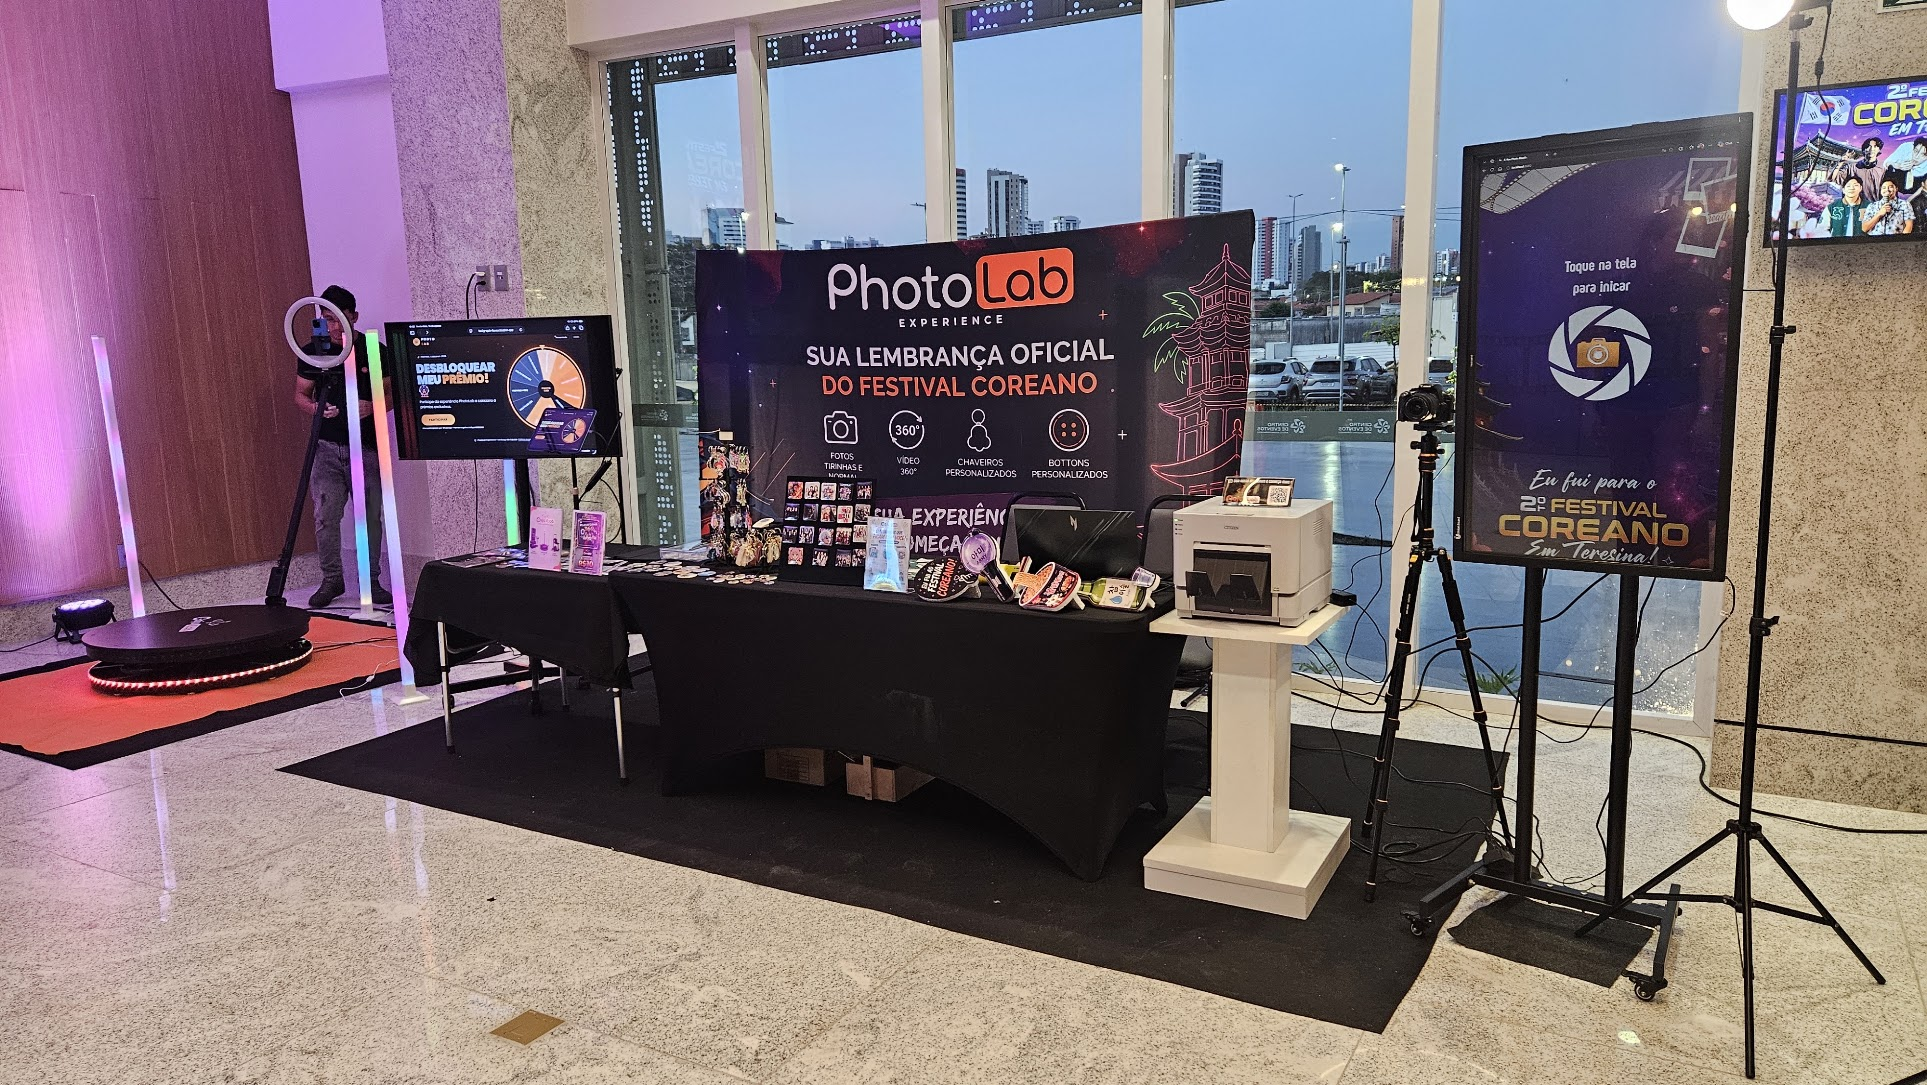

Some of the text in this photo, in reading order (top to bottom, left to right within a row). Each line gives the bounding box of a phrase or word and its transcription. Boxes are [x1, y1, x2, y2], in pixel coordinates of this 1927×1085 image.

[1853, 99, 1927, 125] COR
[1889, 122, 1913, 136] EM
[1564, 257, 1637, 275] Toque na tela
[1572, 281, 1631, 296] para inicar
[899, 314, 1004, 328] EXPERIENCE
[806, 338, 1115, 371] SUA LEMBRANÇA OFICIAL
[415, 361, 496, 374] DESBLOQUEAR
[416, 371, 489, 385] MEU PRÊMIO!
[821, 371, 1098, 397] DO FESTIVAL COREANO
[830, 452, 854, 461] FOTOS
[896, 455, 920, 465] VÍDEO
[957, 458, 1004, 467] CHAVEIROS
[1048, 459, 1090, 467] BOTTONS
[824, 463, 863, 472] TIRINHAS E
[945, 469, 1017, 478] PERSONALIZADOS
[1031, 470, 1109, 479] PERSONALIZADOS
[1529, 468, 1657, 494] Eu fui para o
[1551, 498, 1668, 518] FESTIVAL
[1498, 514, 1690, 547] COREANO
[910, 535, 962, 556] MEÇA
[1524, 539, 1660, 564] Em Teresina!
[928, 562, 945, 593] FESTIVAL
[937, 558, 957, 597] COREANO!
